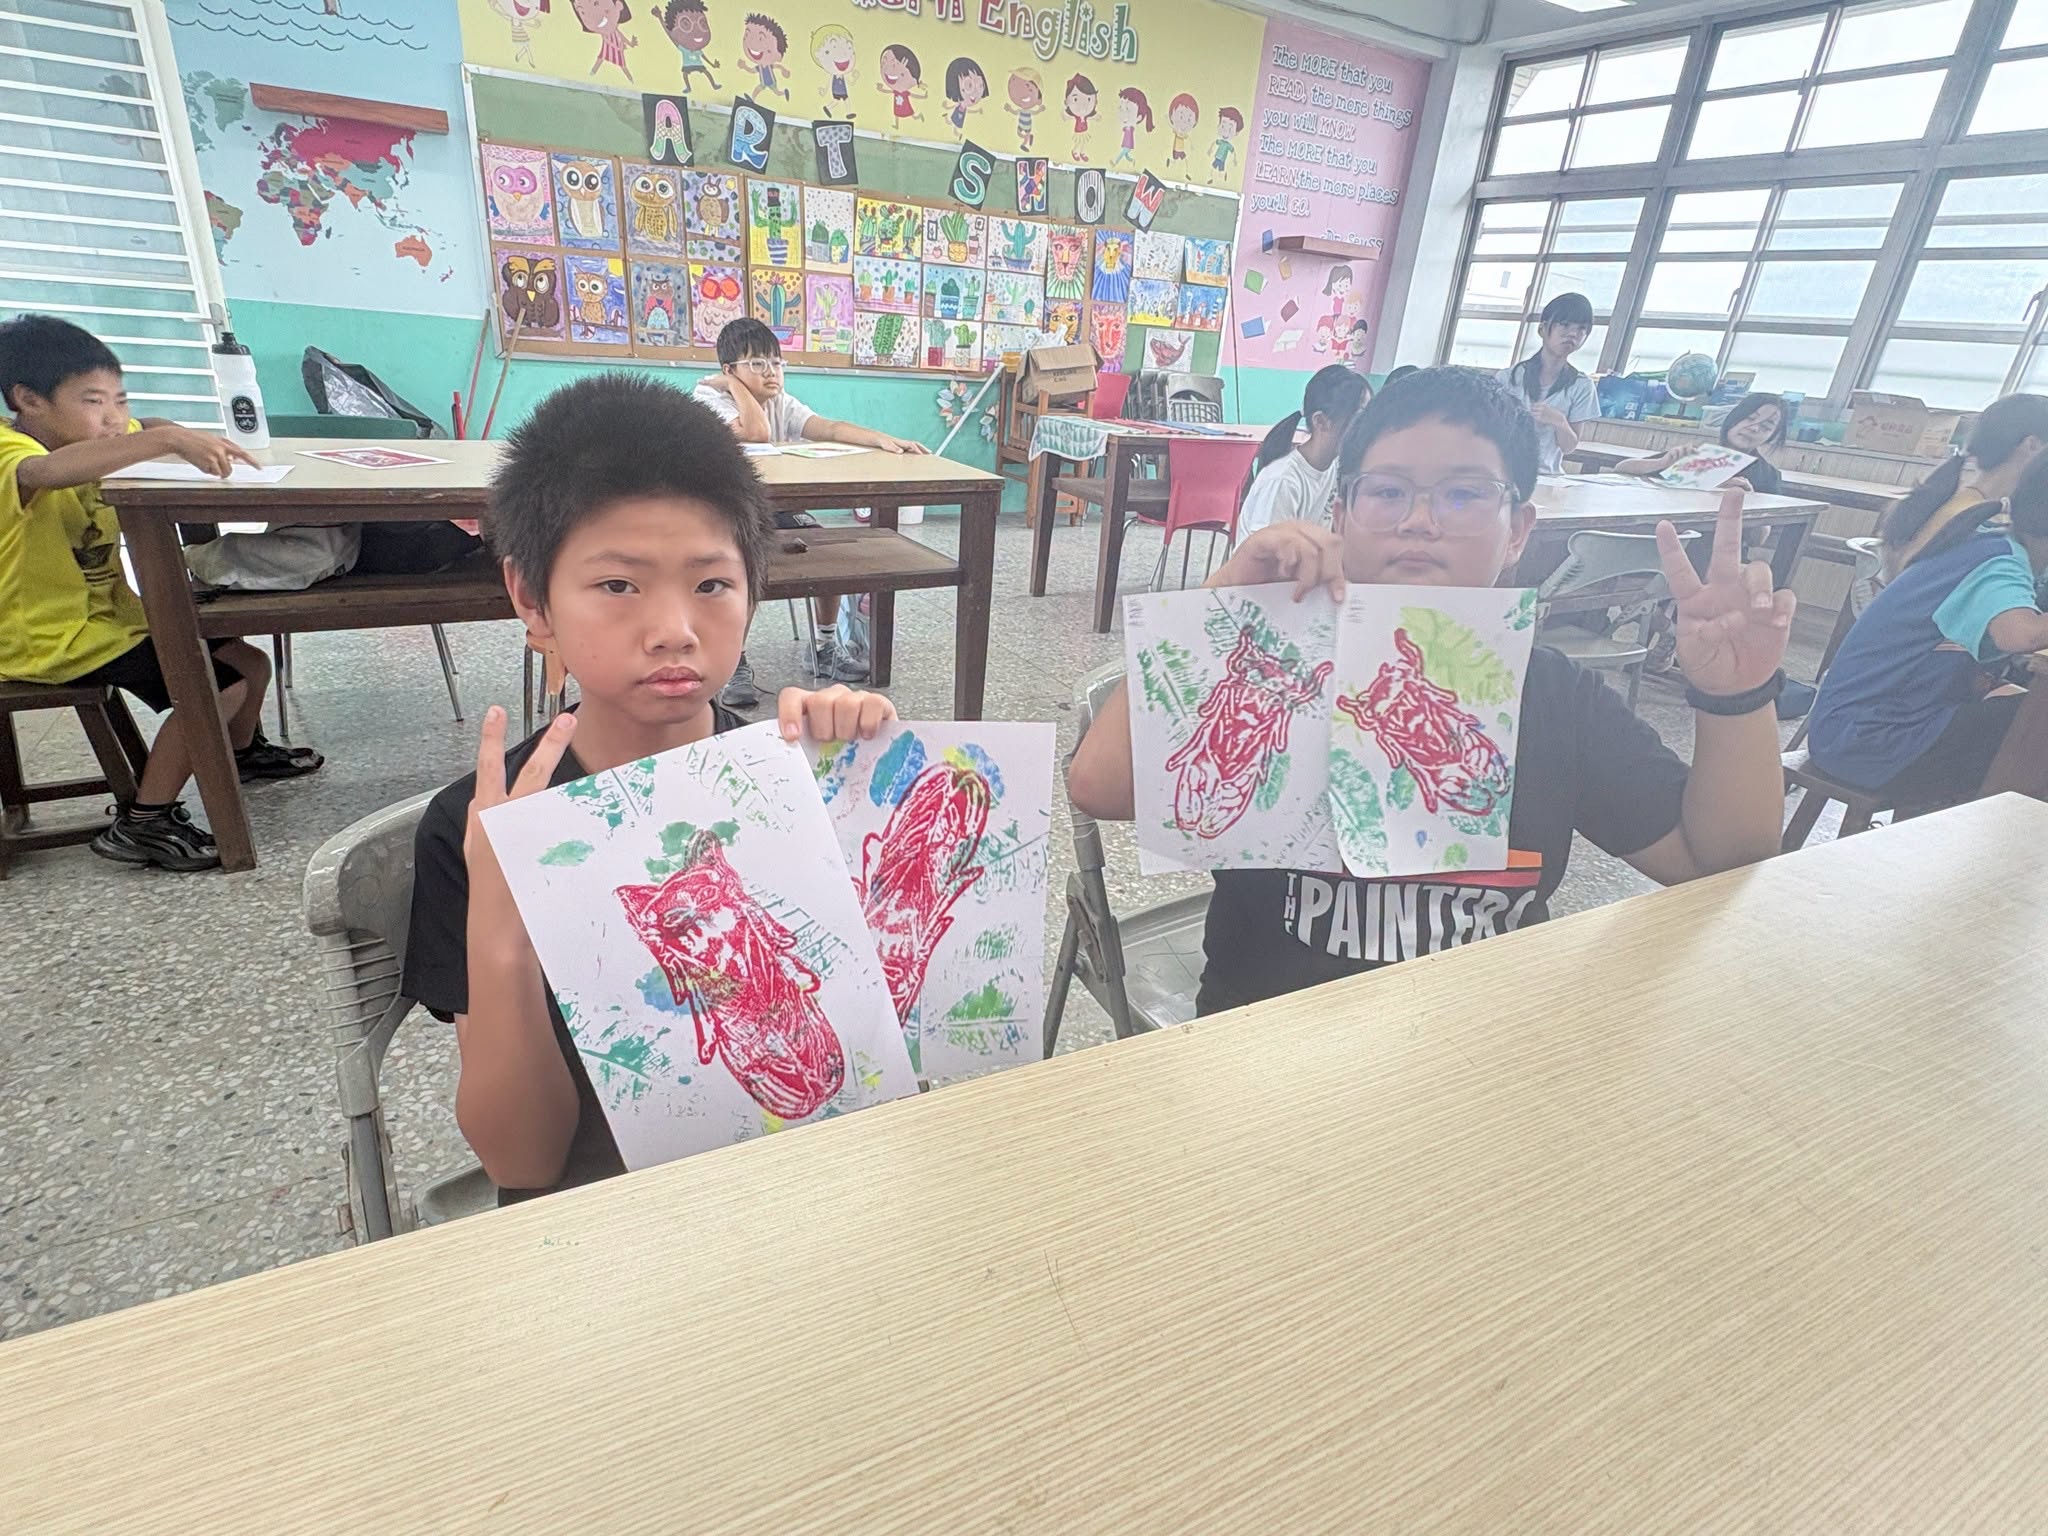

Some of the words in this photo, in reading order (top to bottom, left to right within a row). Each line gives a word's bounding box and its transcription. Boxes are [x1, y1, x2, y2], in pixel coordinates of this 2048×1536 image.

[978, 0, 1136, 62] English
[1272, 45, 1297, 68] The
[1301, 53, 1337, 78] MORE
[1341, 61, 1367, 87] that
[1368, 74, 1392, 93] you
[1263, 108, 1288, 128] you
[1292, 111, 1317, 133] will
[1312, 84, 1333, 107] the
[1335, 94, 1368, 116] more
[1372, 99, 1413, 129] things
[1260, 133, 1283, 156] The
[1287, 140, 1323, 163] MORE
[1327, 146, 1352, 170] that
[1353, 158, 1376, 176] you
[1298, 170, 1320, 191] the
[1322, 178, 1354, 199] more
[1356, 181, 1399, 205] places
